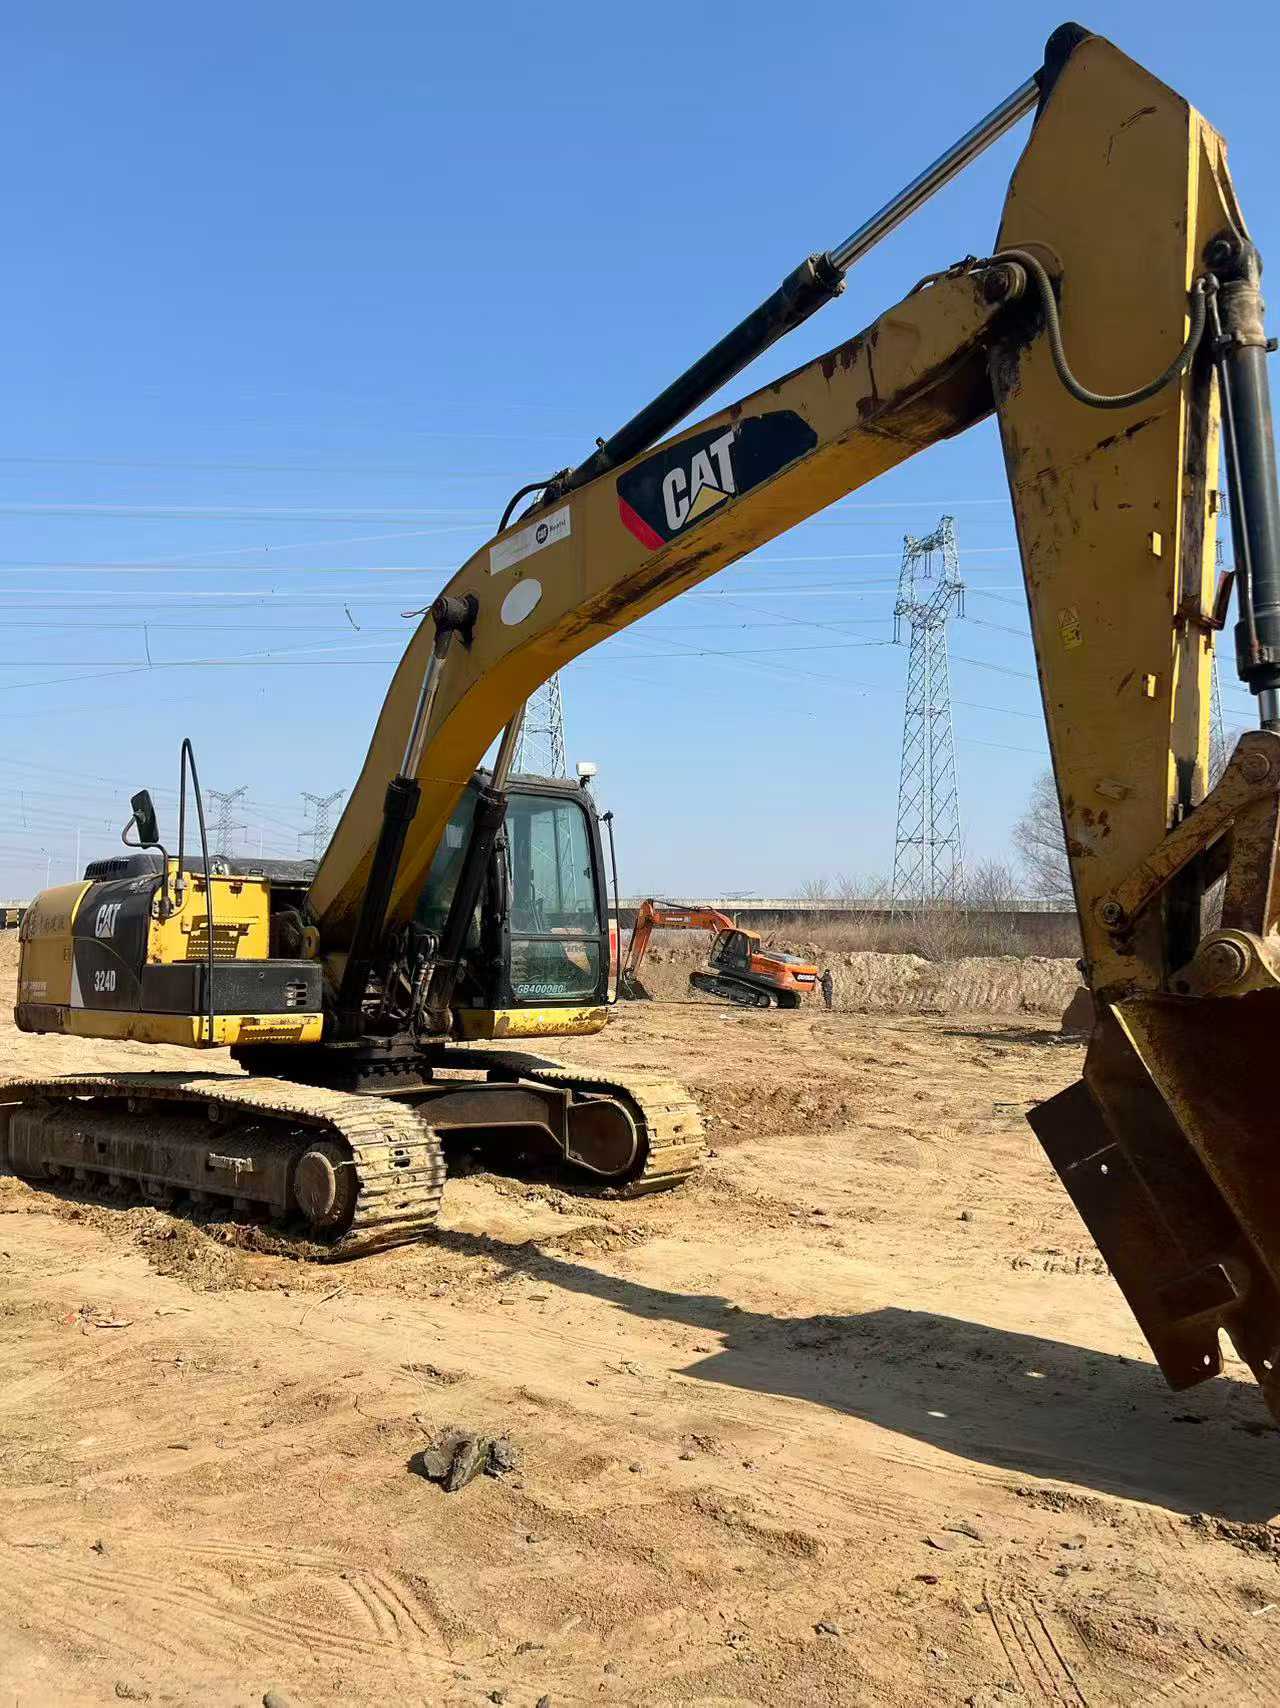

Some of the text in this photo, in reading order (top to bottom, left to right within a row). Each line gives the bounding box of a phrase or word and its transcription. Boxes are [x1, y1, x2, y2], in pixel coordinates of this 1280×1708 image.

[662, 430, 735, 530] CAT
[95, 904, 121, 938] CAT
[94, 970, 116, 992] 324D
